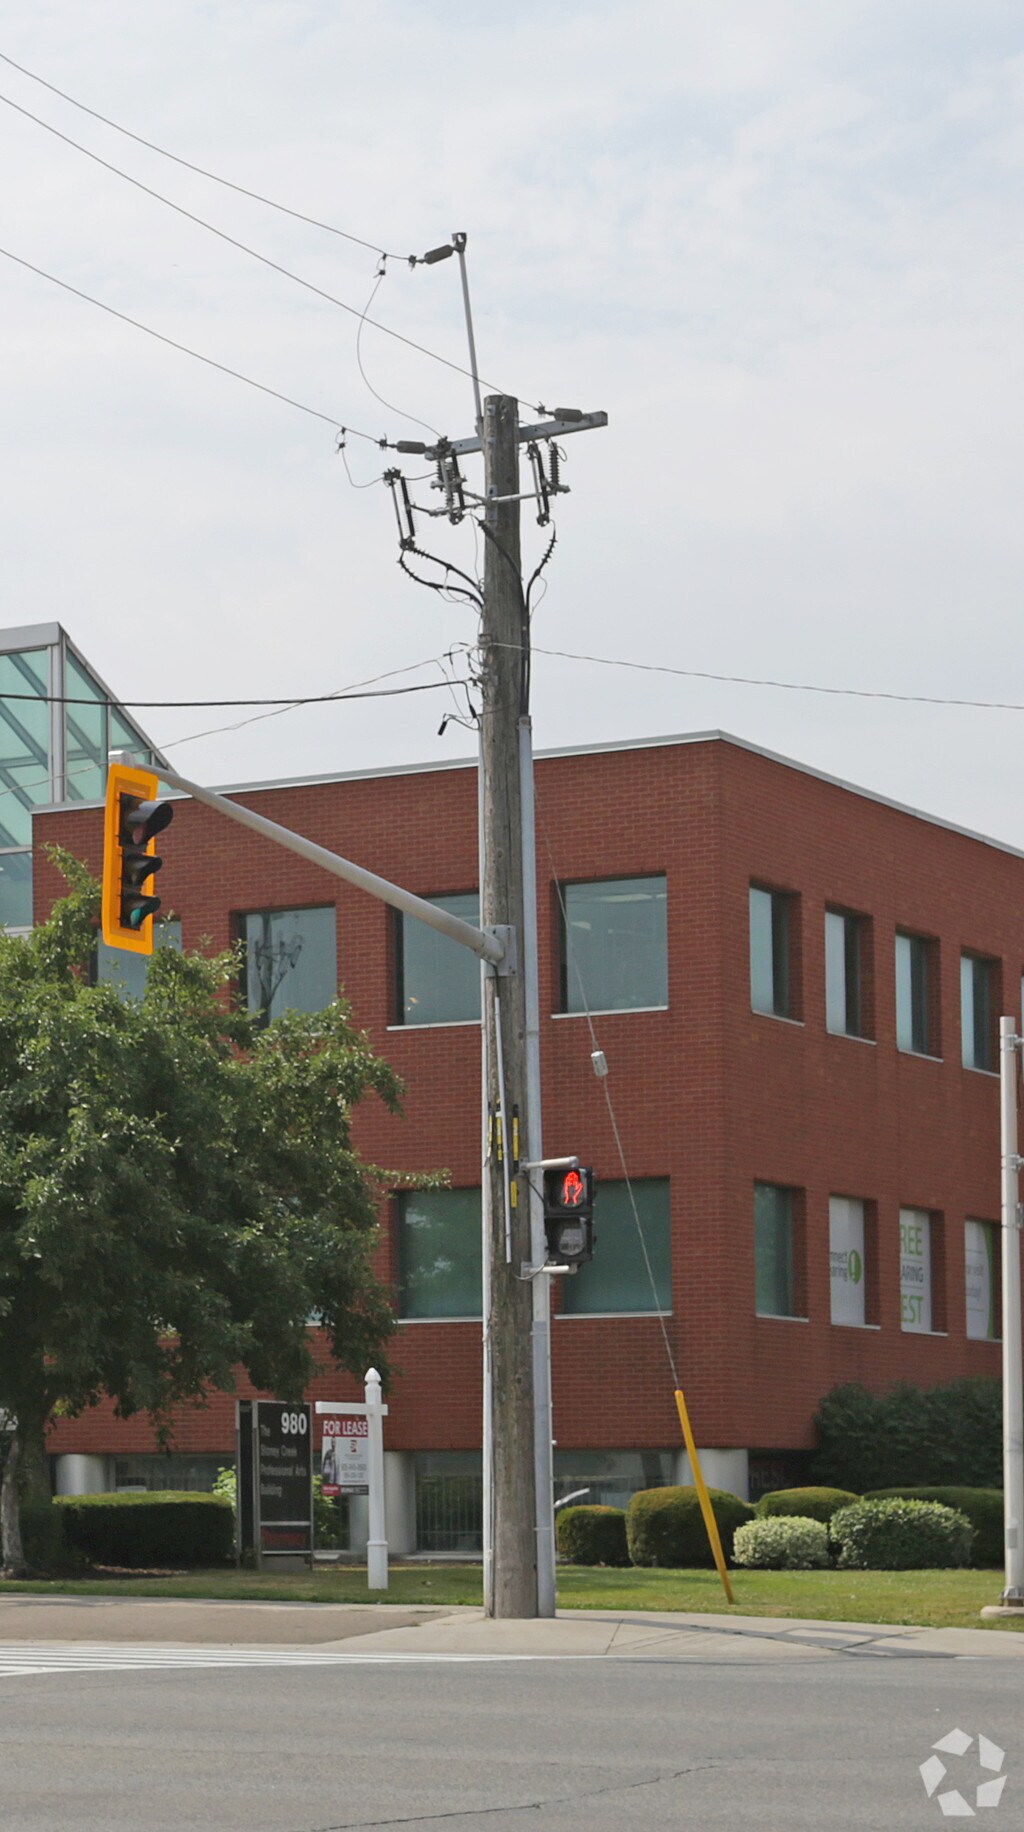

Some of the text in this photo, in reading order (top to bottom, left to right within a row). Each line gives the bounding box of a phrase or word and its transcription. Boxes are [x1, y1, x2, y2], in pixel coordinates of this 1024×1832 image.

[281, 1412, 307, 1435] 980
[323, 1420, 369, 1436] FOR LEASE
